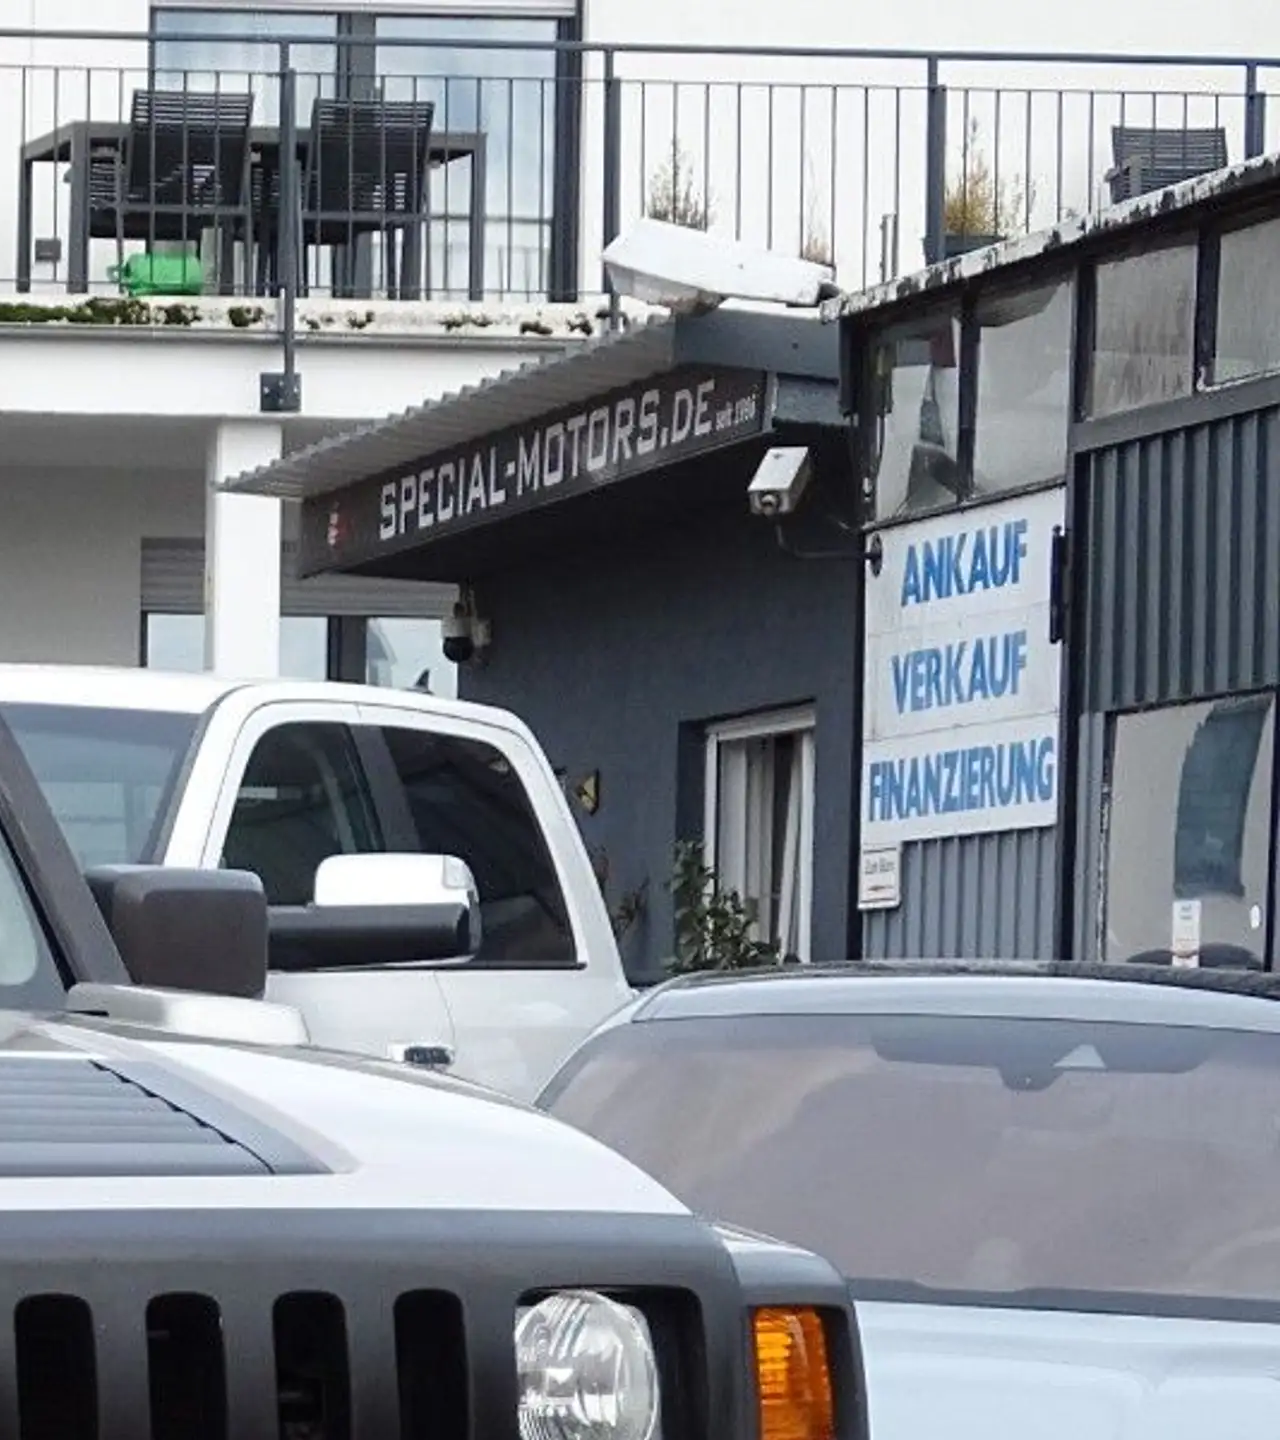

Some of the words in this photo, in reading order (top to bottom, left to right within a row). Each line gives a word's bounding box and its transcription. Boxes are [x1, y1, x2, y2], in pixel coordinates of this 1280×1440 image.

[378, 379, 715, 541] SPECIAL-MOTORS.DE
[901, 518, 1028, 607] ANKAUF
[892, 630, 1027, 715] VERKAUF
[869, 737, 1054, 822] FINANZIERUNG
